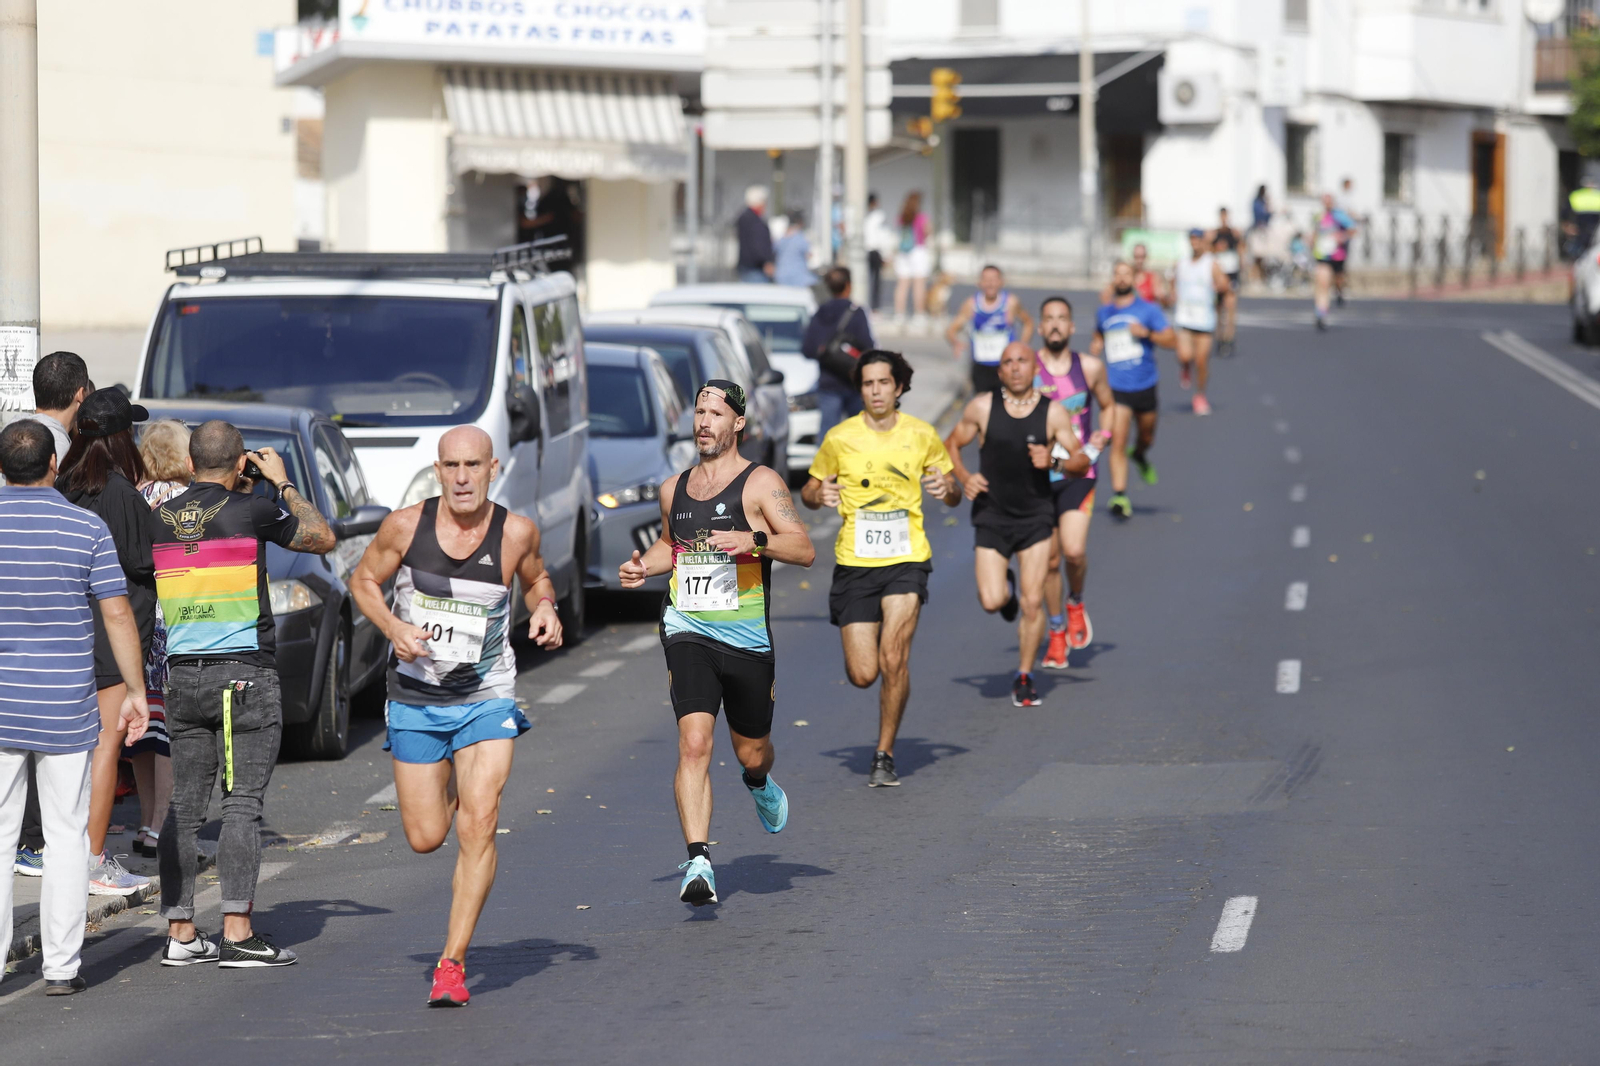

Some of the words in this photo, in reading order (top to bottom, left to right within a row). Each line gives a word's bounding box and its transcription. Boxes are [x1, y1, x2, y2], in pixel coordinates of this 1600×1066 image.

[426, 22, 559, 40] PATATAS
[572, 28, 673, 44] FRITAS
[865, 529, 892, 545] 678
[703, 555, 708, 564] A
[709, 554, 731, 564] HUELVA
[685, 576, 712, 595] 177
[425, 599, 449, 612] VUELTA
[450, 602, 456, 612] A
[457, 604, 482, 616] HUELVA
